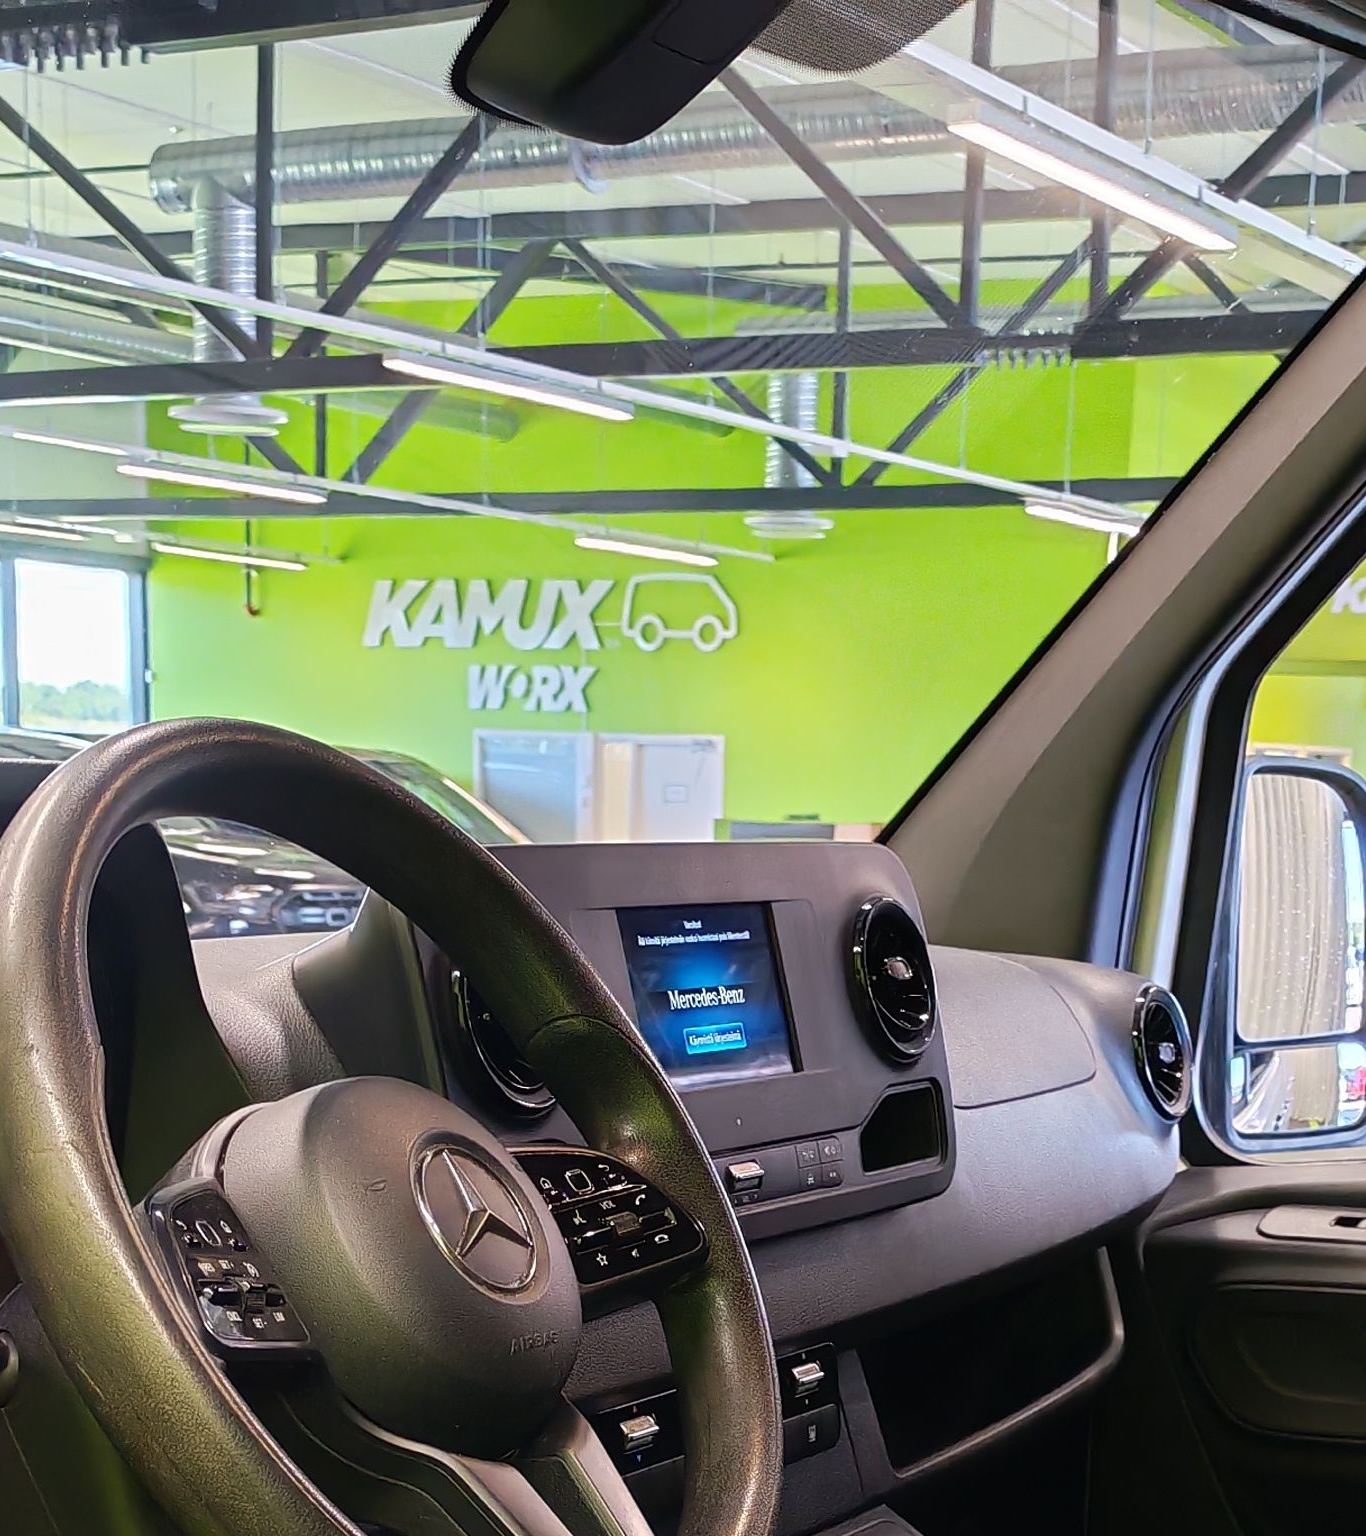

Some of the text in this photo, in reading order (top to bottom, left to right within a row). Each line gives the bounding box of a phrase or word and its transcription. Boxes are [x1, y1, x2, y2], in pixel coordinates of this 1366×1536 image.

[363, 579, 615, 650] KAMUX
[467, 664, 598, 712] WORX
[667, 985, 746, 1011] Mercedes-Benz
